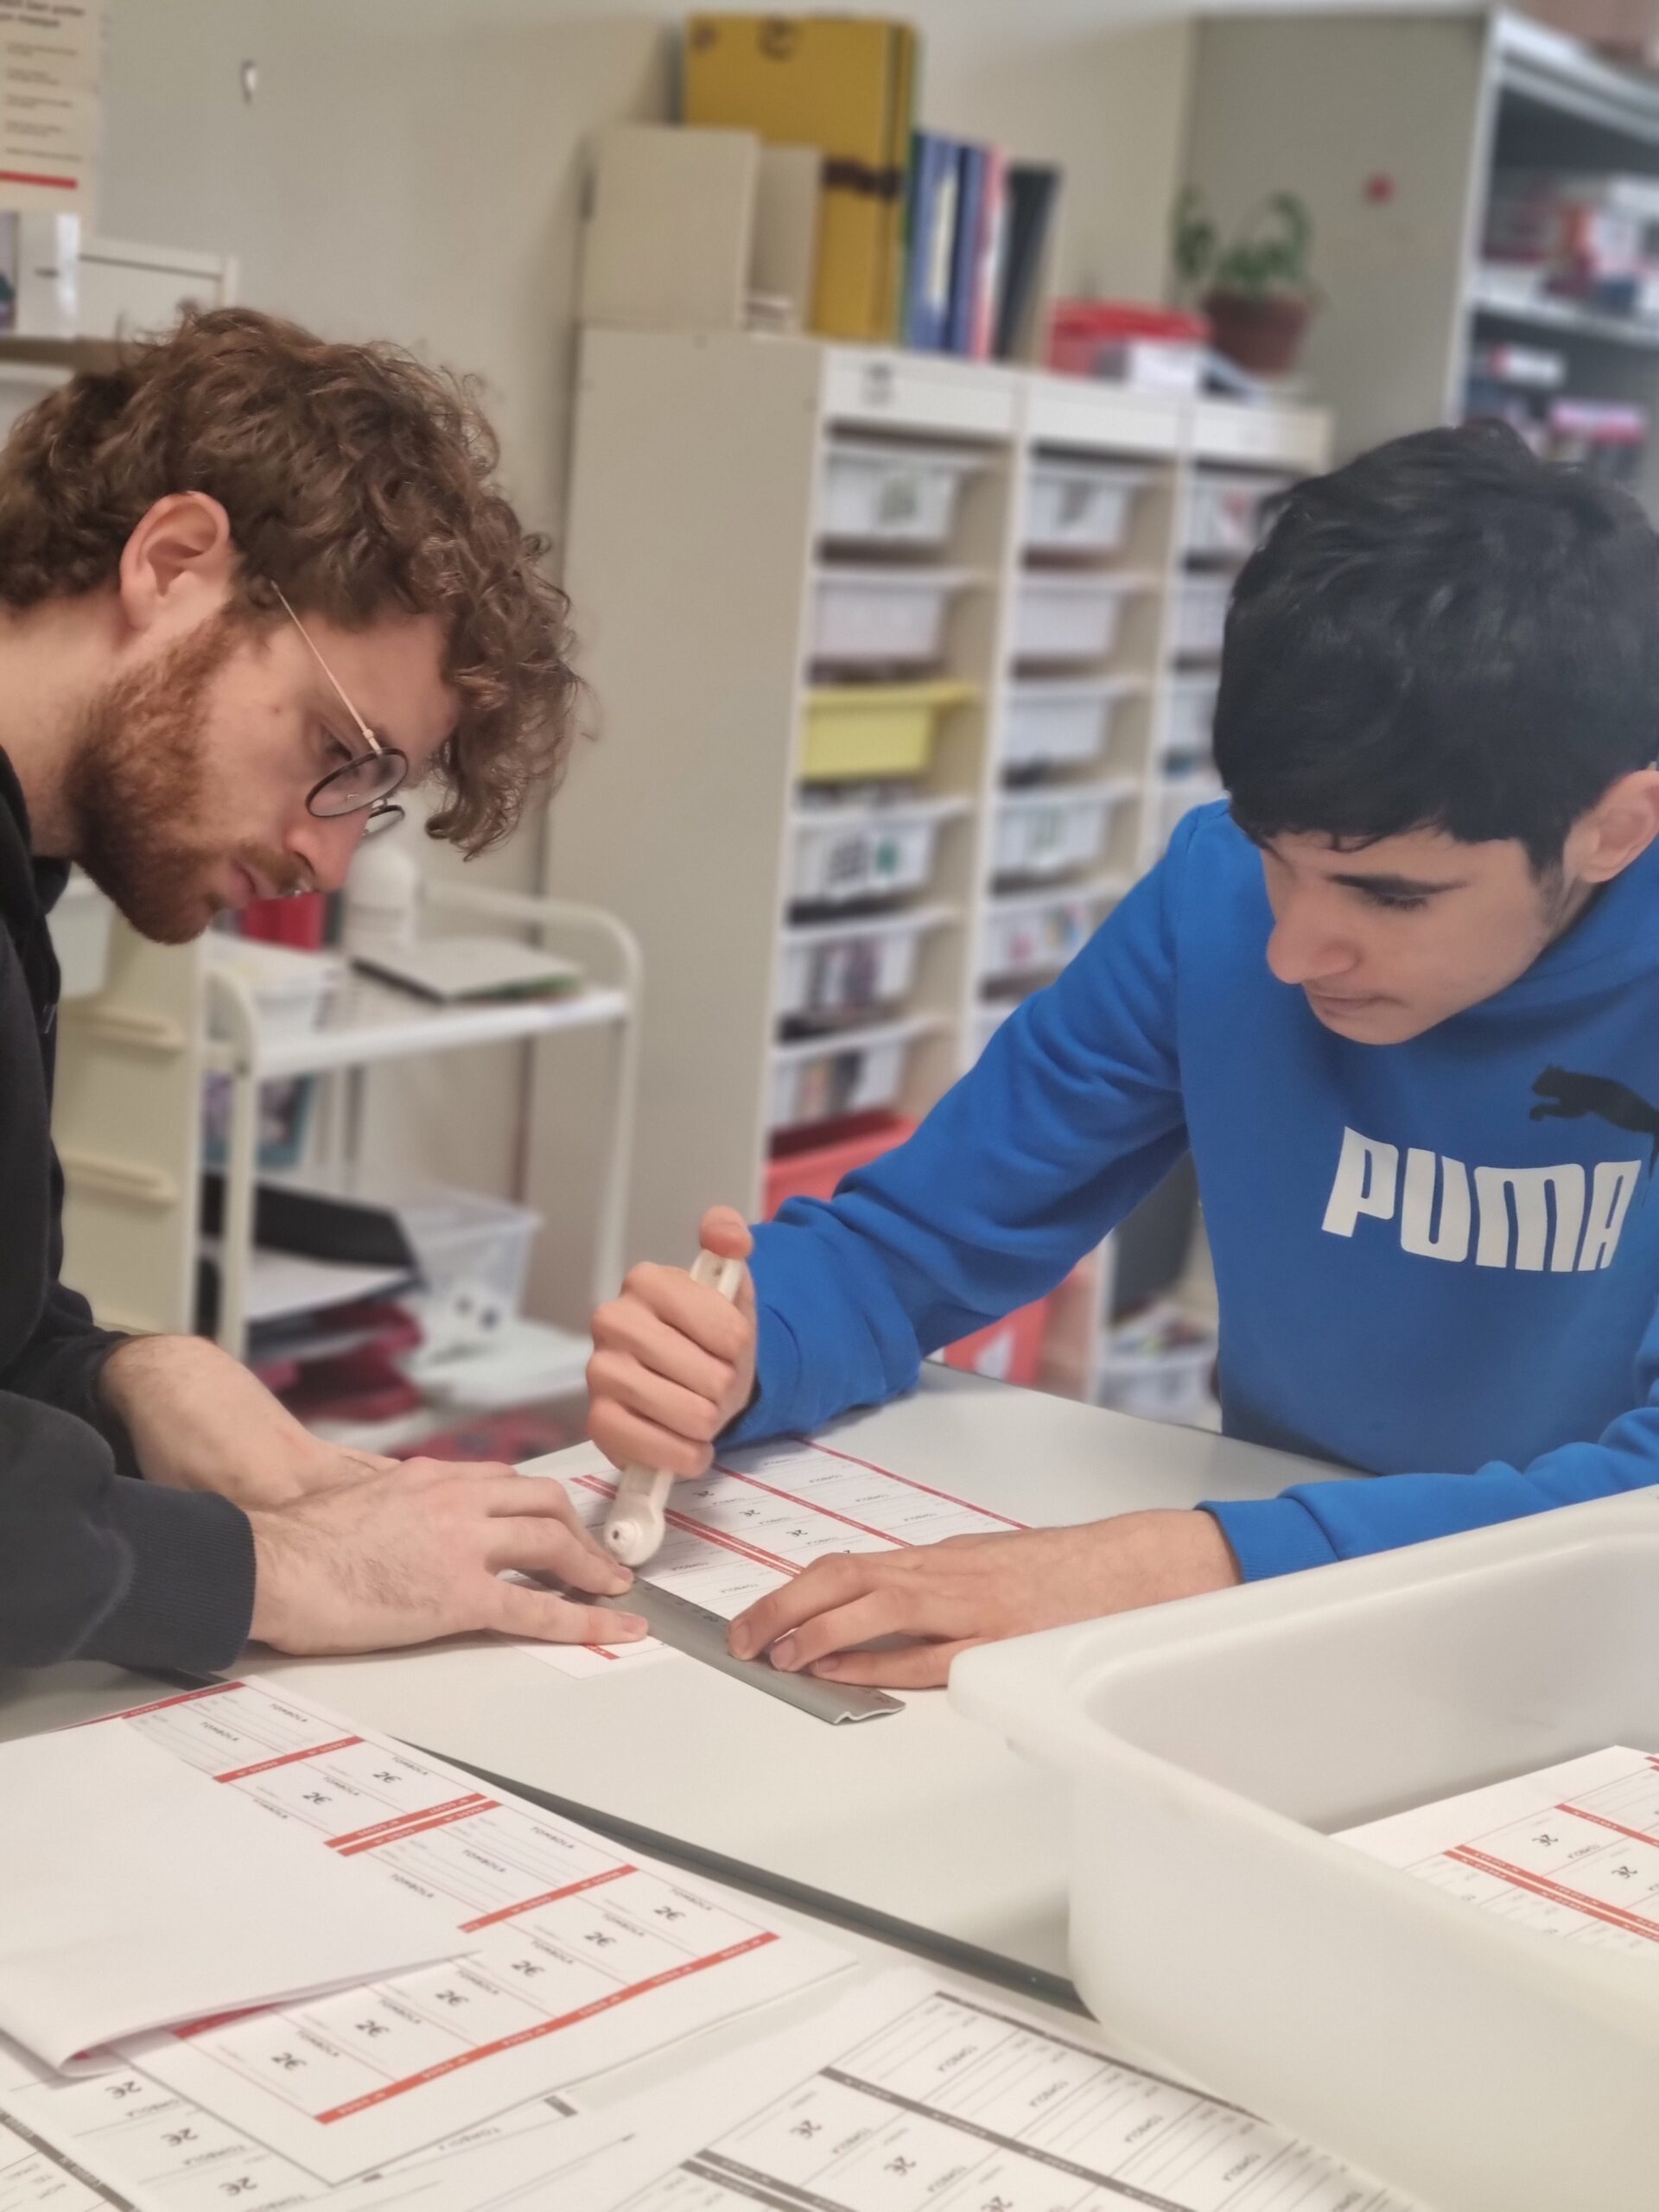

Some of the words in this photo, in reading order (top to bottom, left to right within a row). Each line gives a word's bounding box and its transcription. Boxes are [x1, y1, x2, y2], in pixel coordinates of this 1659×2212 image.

[1321, 1126, 1641, 1272] PUMA
[531, 1827, 574, 1849] TOMBOLA
[462, 1849, 506, 1872] TOMBOLA
